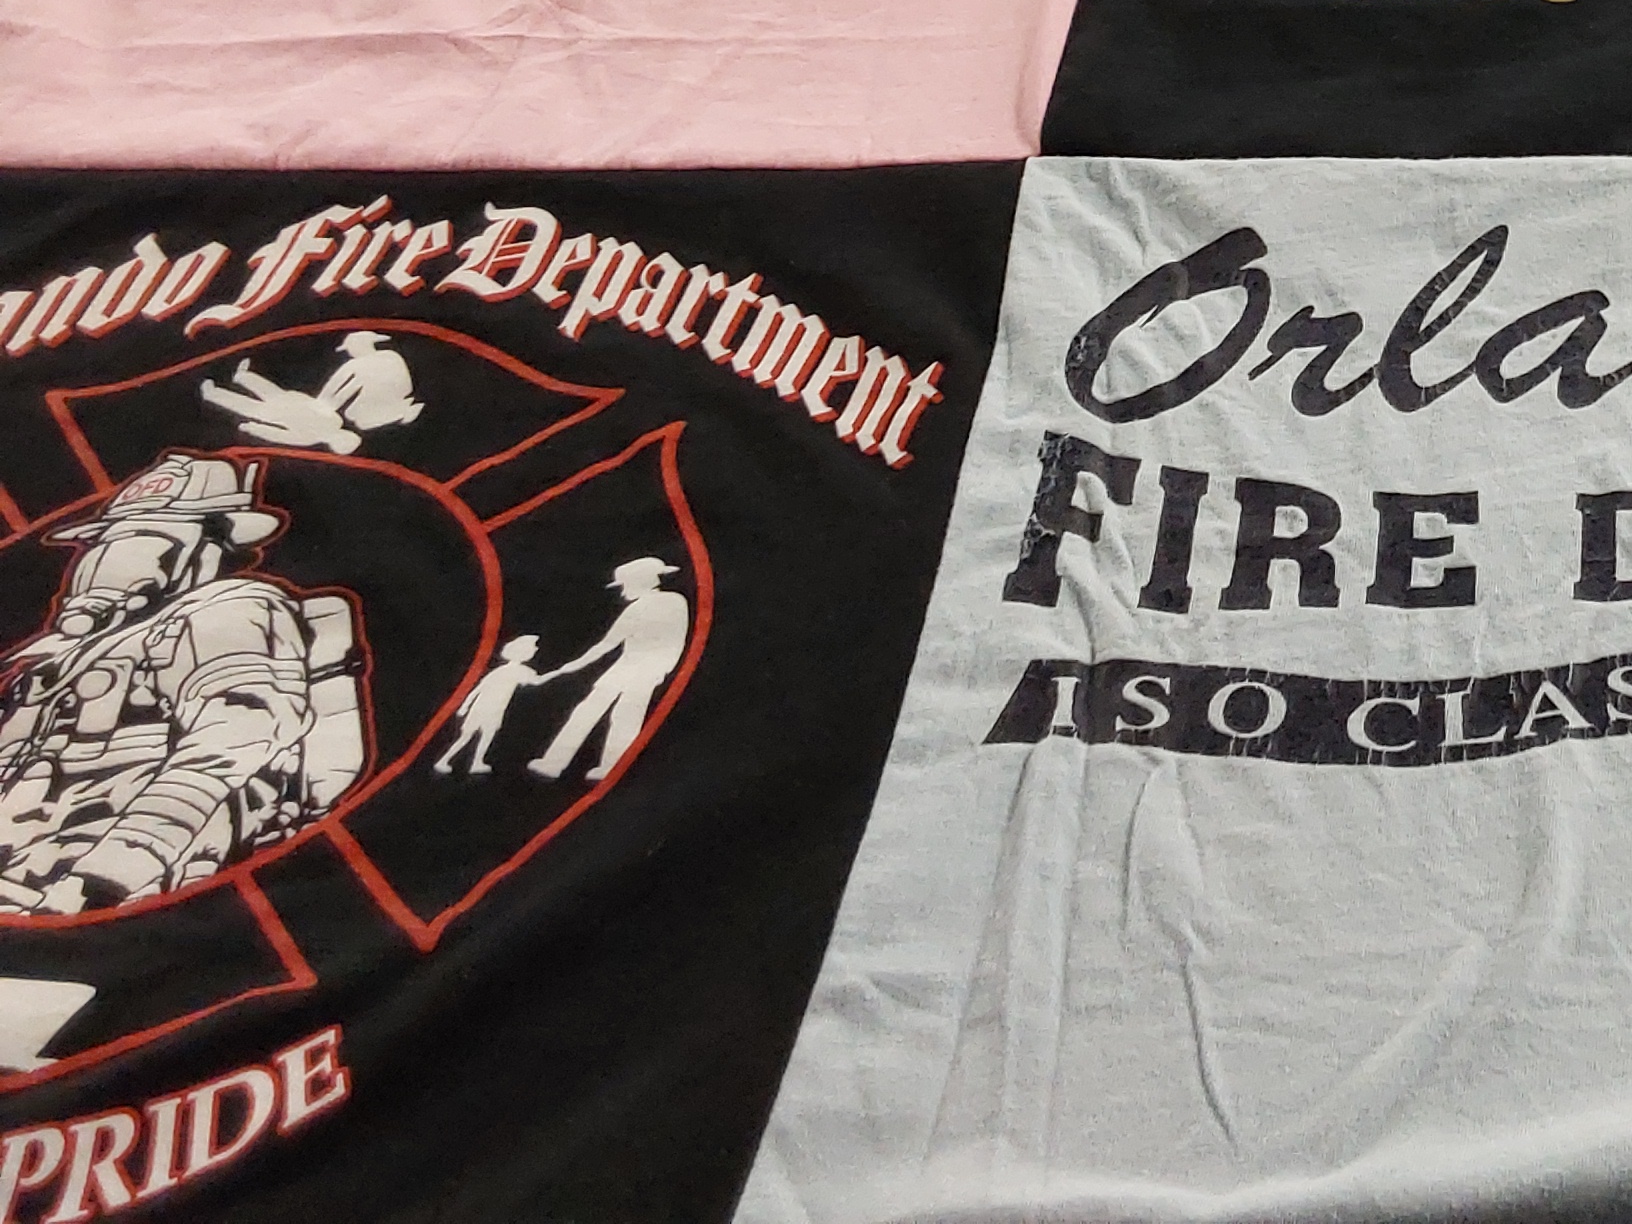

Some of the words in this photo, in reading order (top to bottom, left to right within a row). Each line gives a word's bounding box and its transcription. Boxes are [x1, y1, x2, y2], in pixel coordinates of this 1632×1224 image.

[185, 194, 451, 336] Fire
[436, 199, 948, 470] Department
[122, 477, 174, 501] OFD
[1001, 429, 1482, 615] FIRE
[1049, 671, 1291, 741] ISO
[0, 1023, 351, 1224] PRIDE
